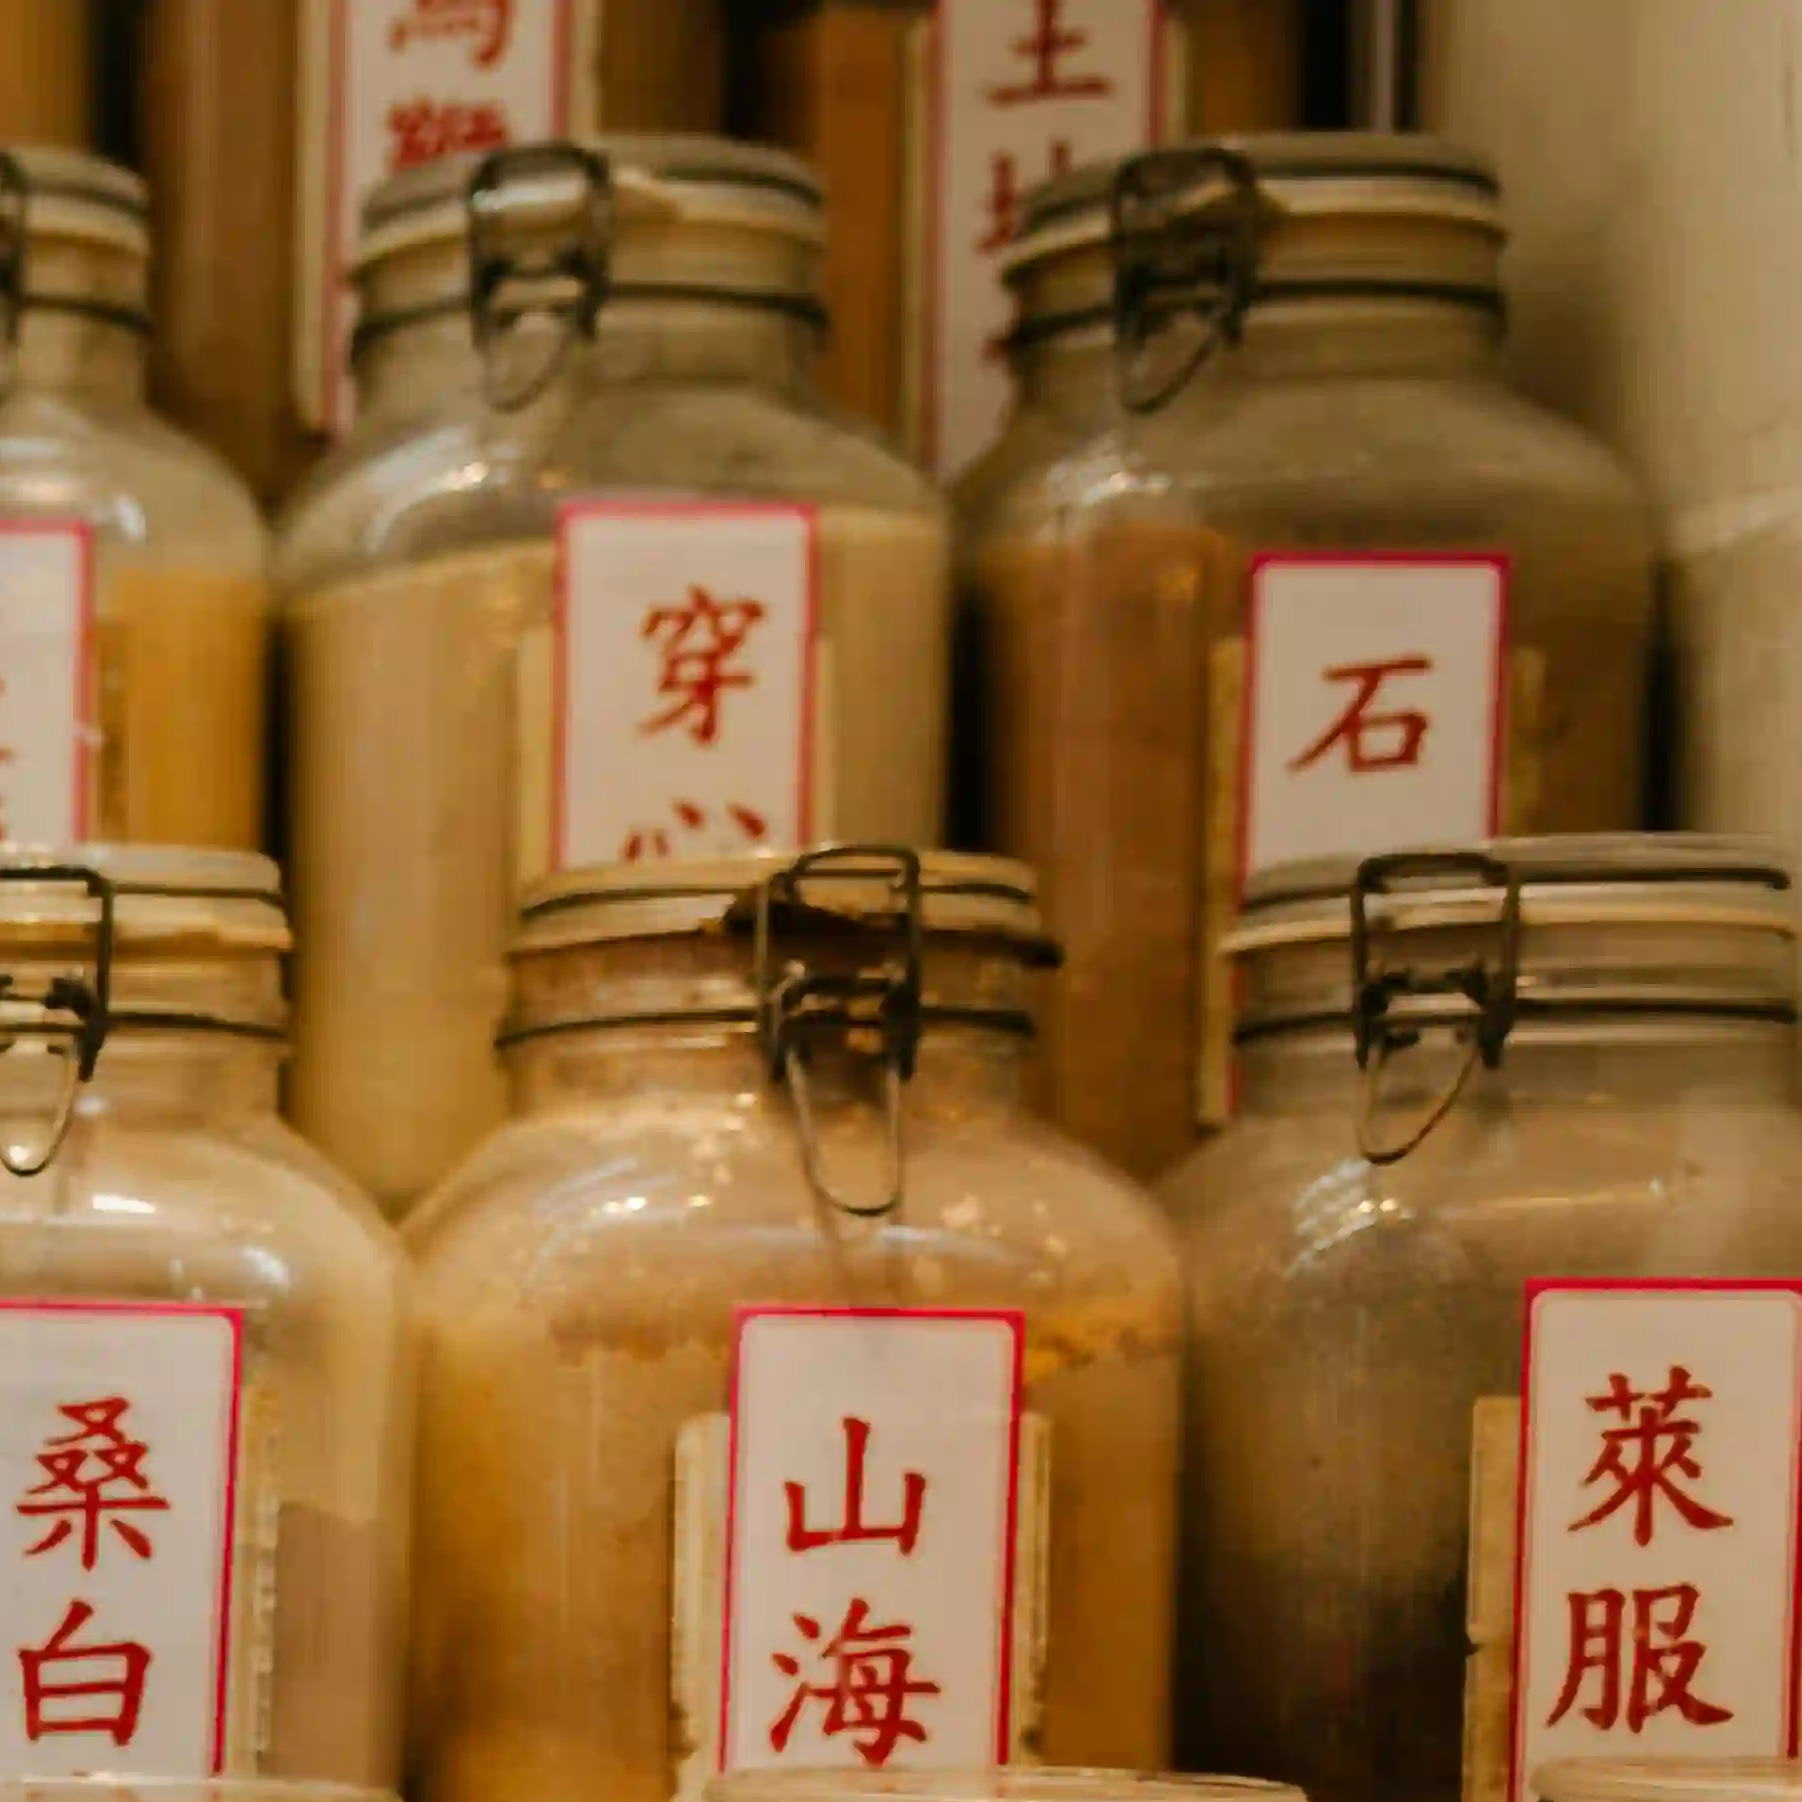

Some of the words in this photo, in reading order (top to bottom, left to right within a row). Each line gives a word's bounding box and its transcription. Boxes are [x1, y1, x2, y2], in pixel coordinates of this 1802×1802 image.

[1287, 654, 1430, 774] 石
[19, 1396, 168, 1747] 桑白
[769, 1417, 937, 1768] 山海
[1549, 1367, 1730, 1733] 萊服
